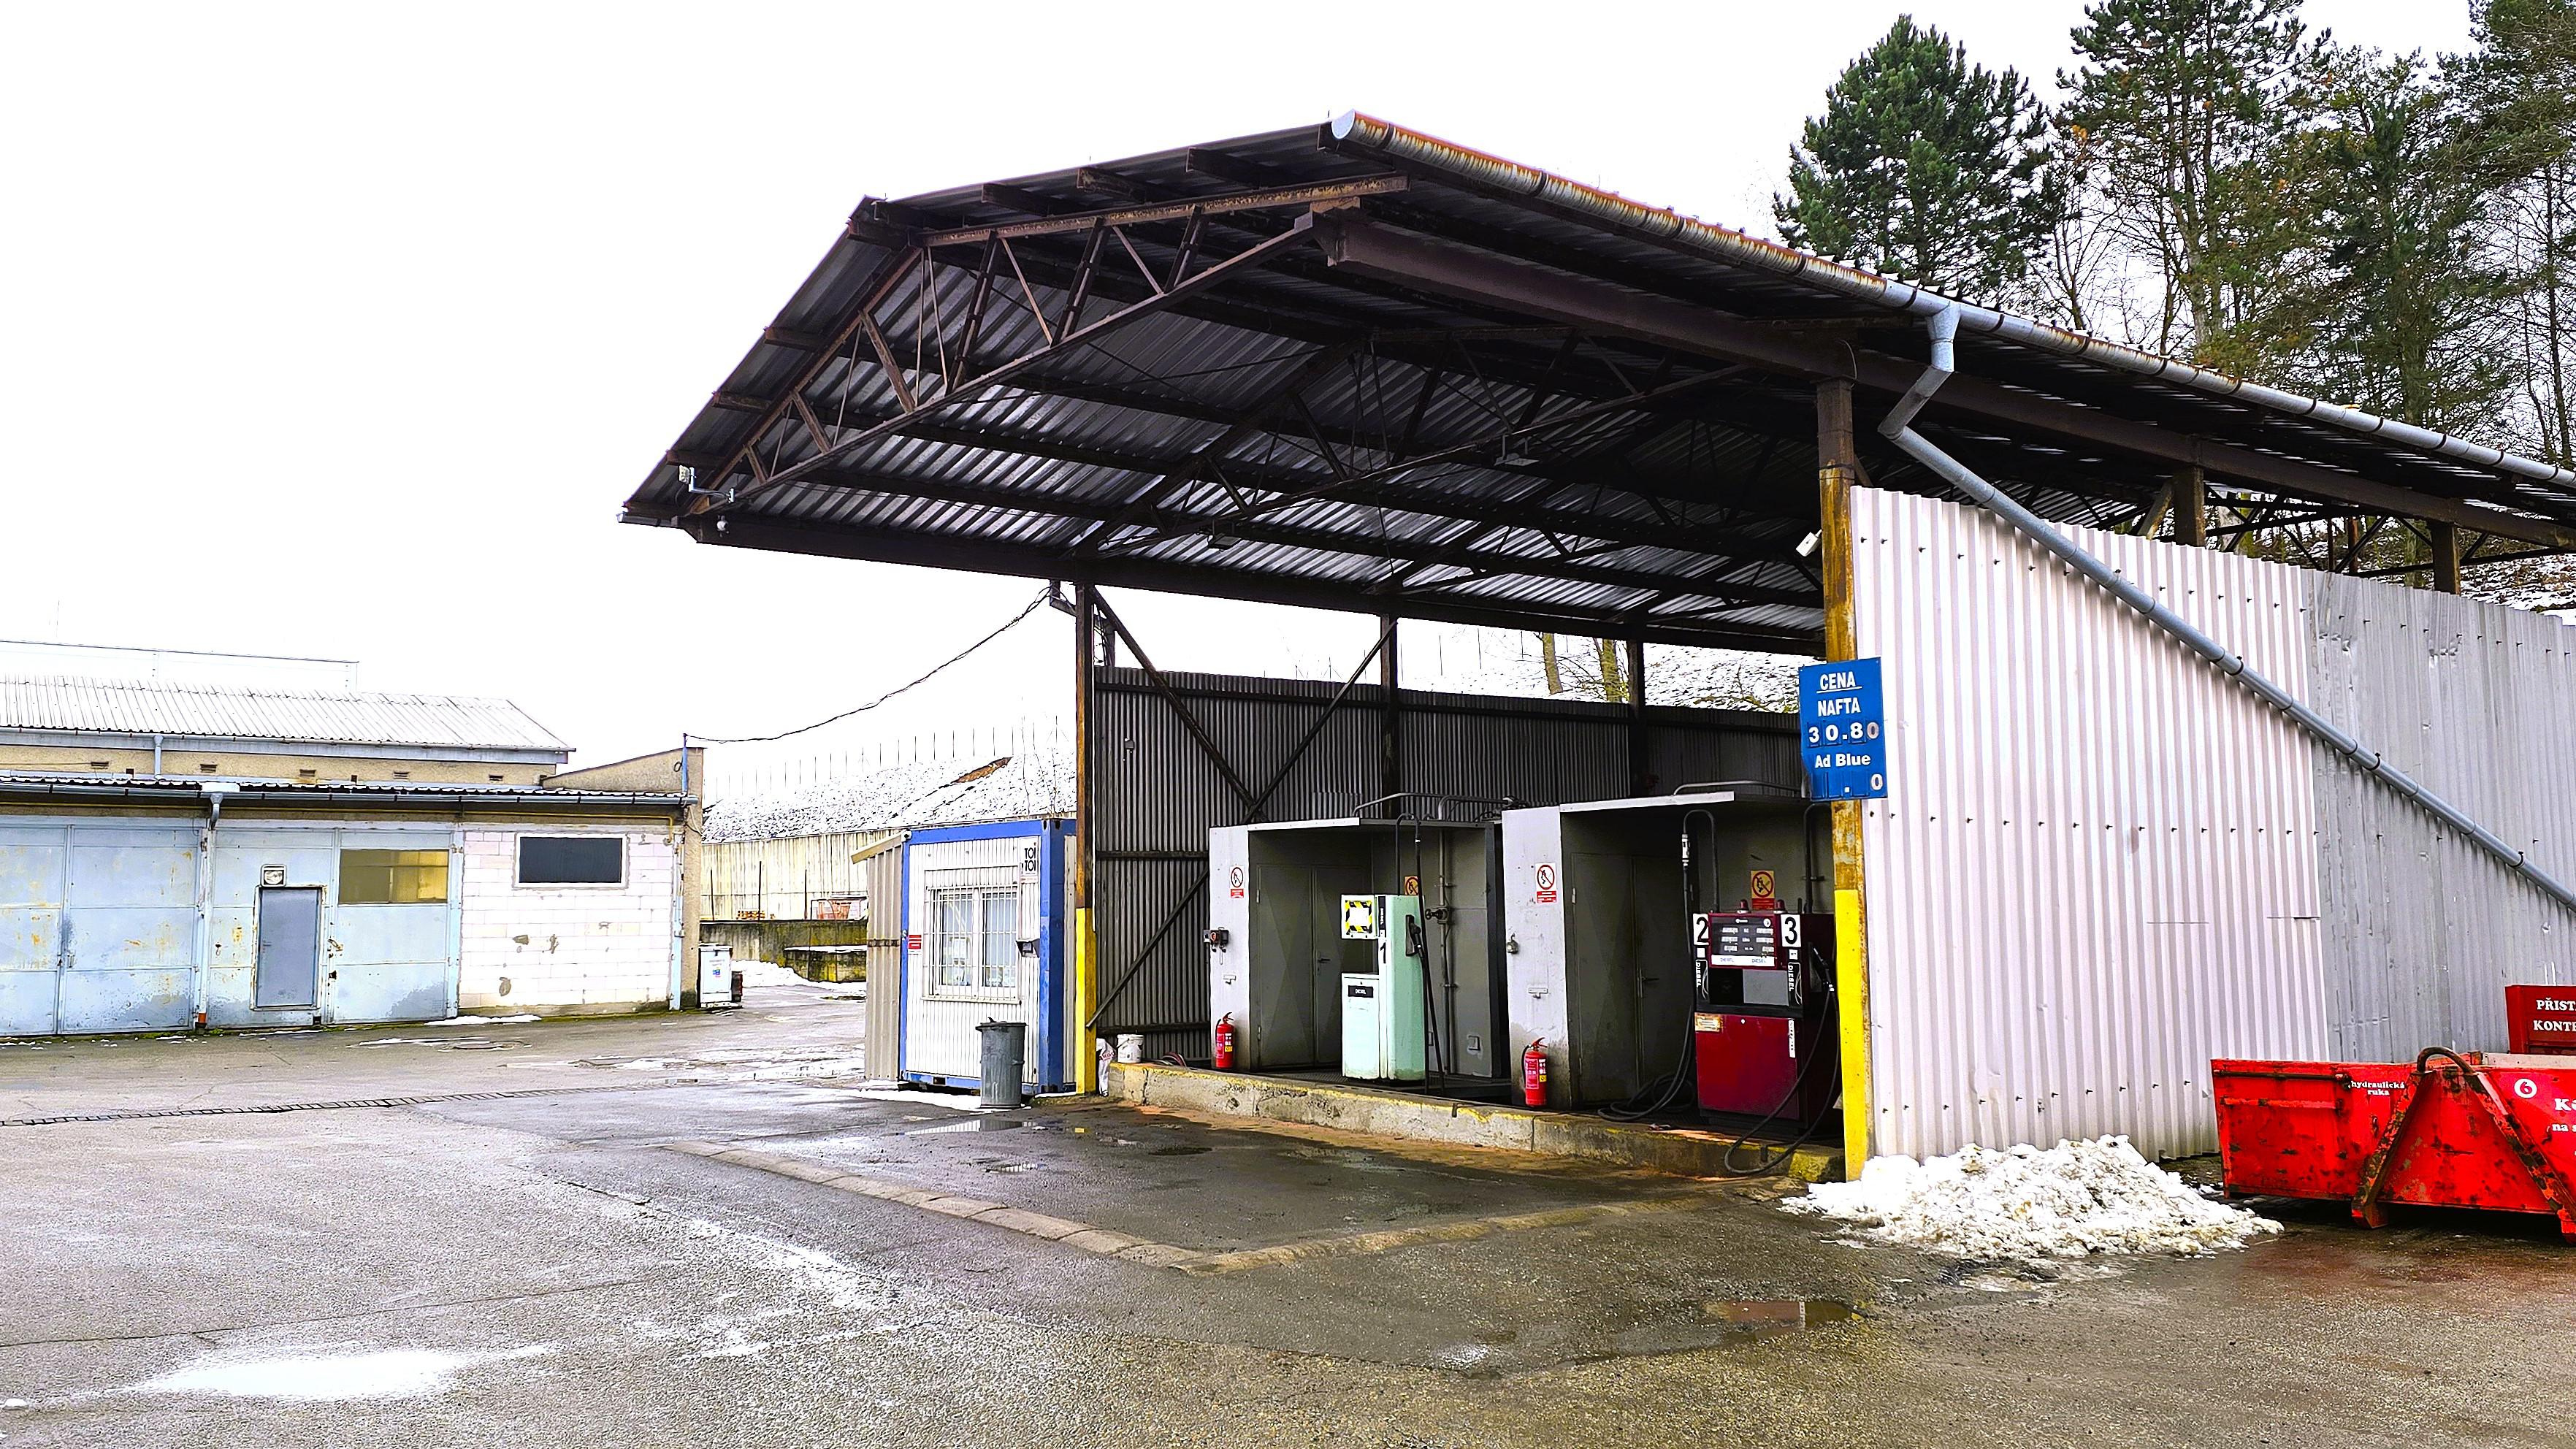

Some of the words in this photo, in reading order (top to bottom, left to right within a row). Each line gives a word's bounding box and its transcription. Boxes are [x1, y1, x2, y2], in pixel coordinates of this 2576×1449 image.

[1820, 671, 1856, 691] CENA
[1818, 697, 1861, 716] NAFTA
[1808, 722, 1879, 743] 30.80
[1815, 754, 1831, 768] Ad
[1835, 753, 1871, 767] Blue
[1024, 860, 1036, 871] TOI
[1696, 917, 1708, 942] 2
[1784, 917, 1797, 944] 3
[1380, 942, 1386, 963] 1
[2536, 997, 2576, 1011] PŘIST
[2350, 1080, 2405, 1089] hydraulická
[2520, 1081, 2533, 1095] 6
[2552, 1123, 2569, 1132] na
